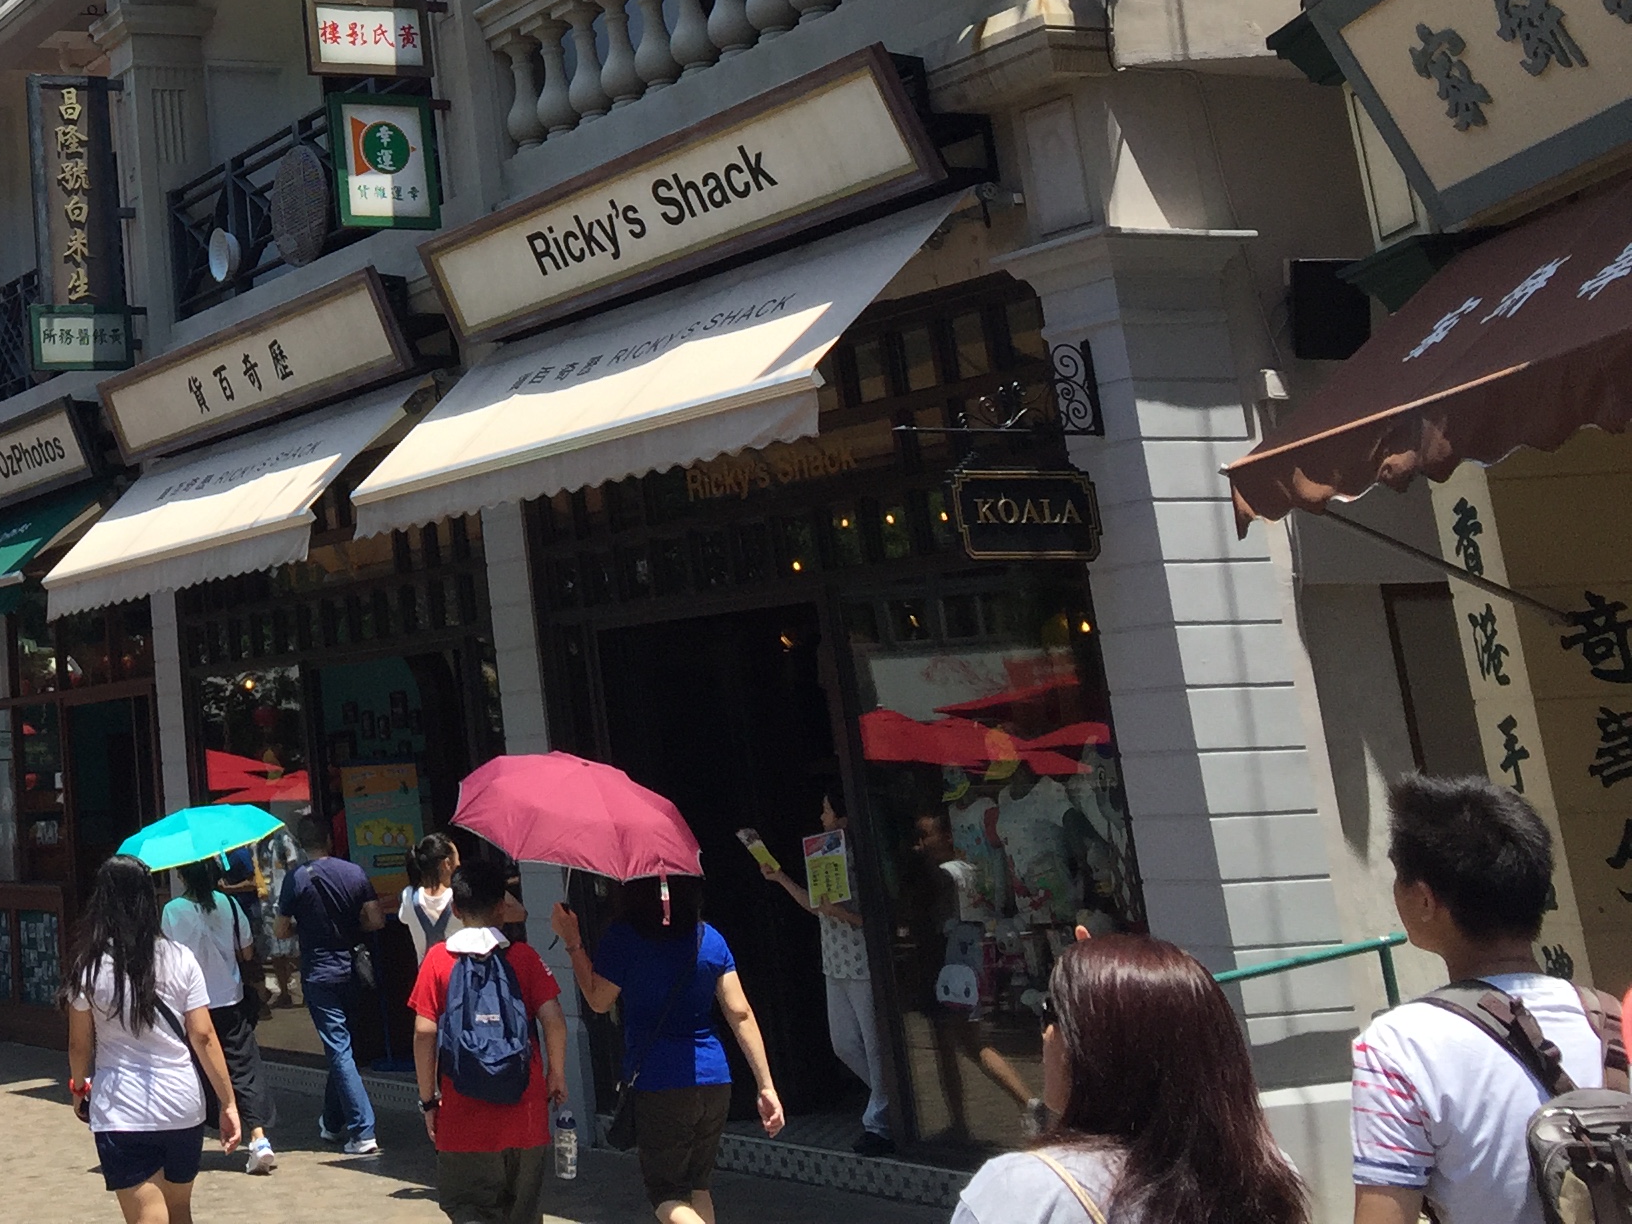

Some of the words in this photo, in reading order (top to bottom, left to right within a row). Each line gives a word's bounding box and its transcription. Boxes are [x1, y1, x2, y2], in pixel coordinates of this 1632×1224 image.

[525, 201, 647, 278] Ricky's
[658, 144, 779, 226] Shack
[703, 292, 797, 331] SHACK
[974, 497, 1083, 526] KOALA
